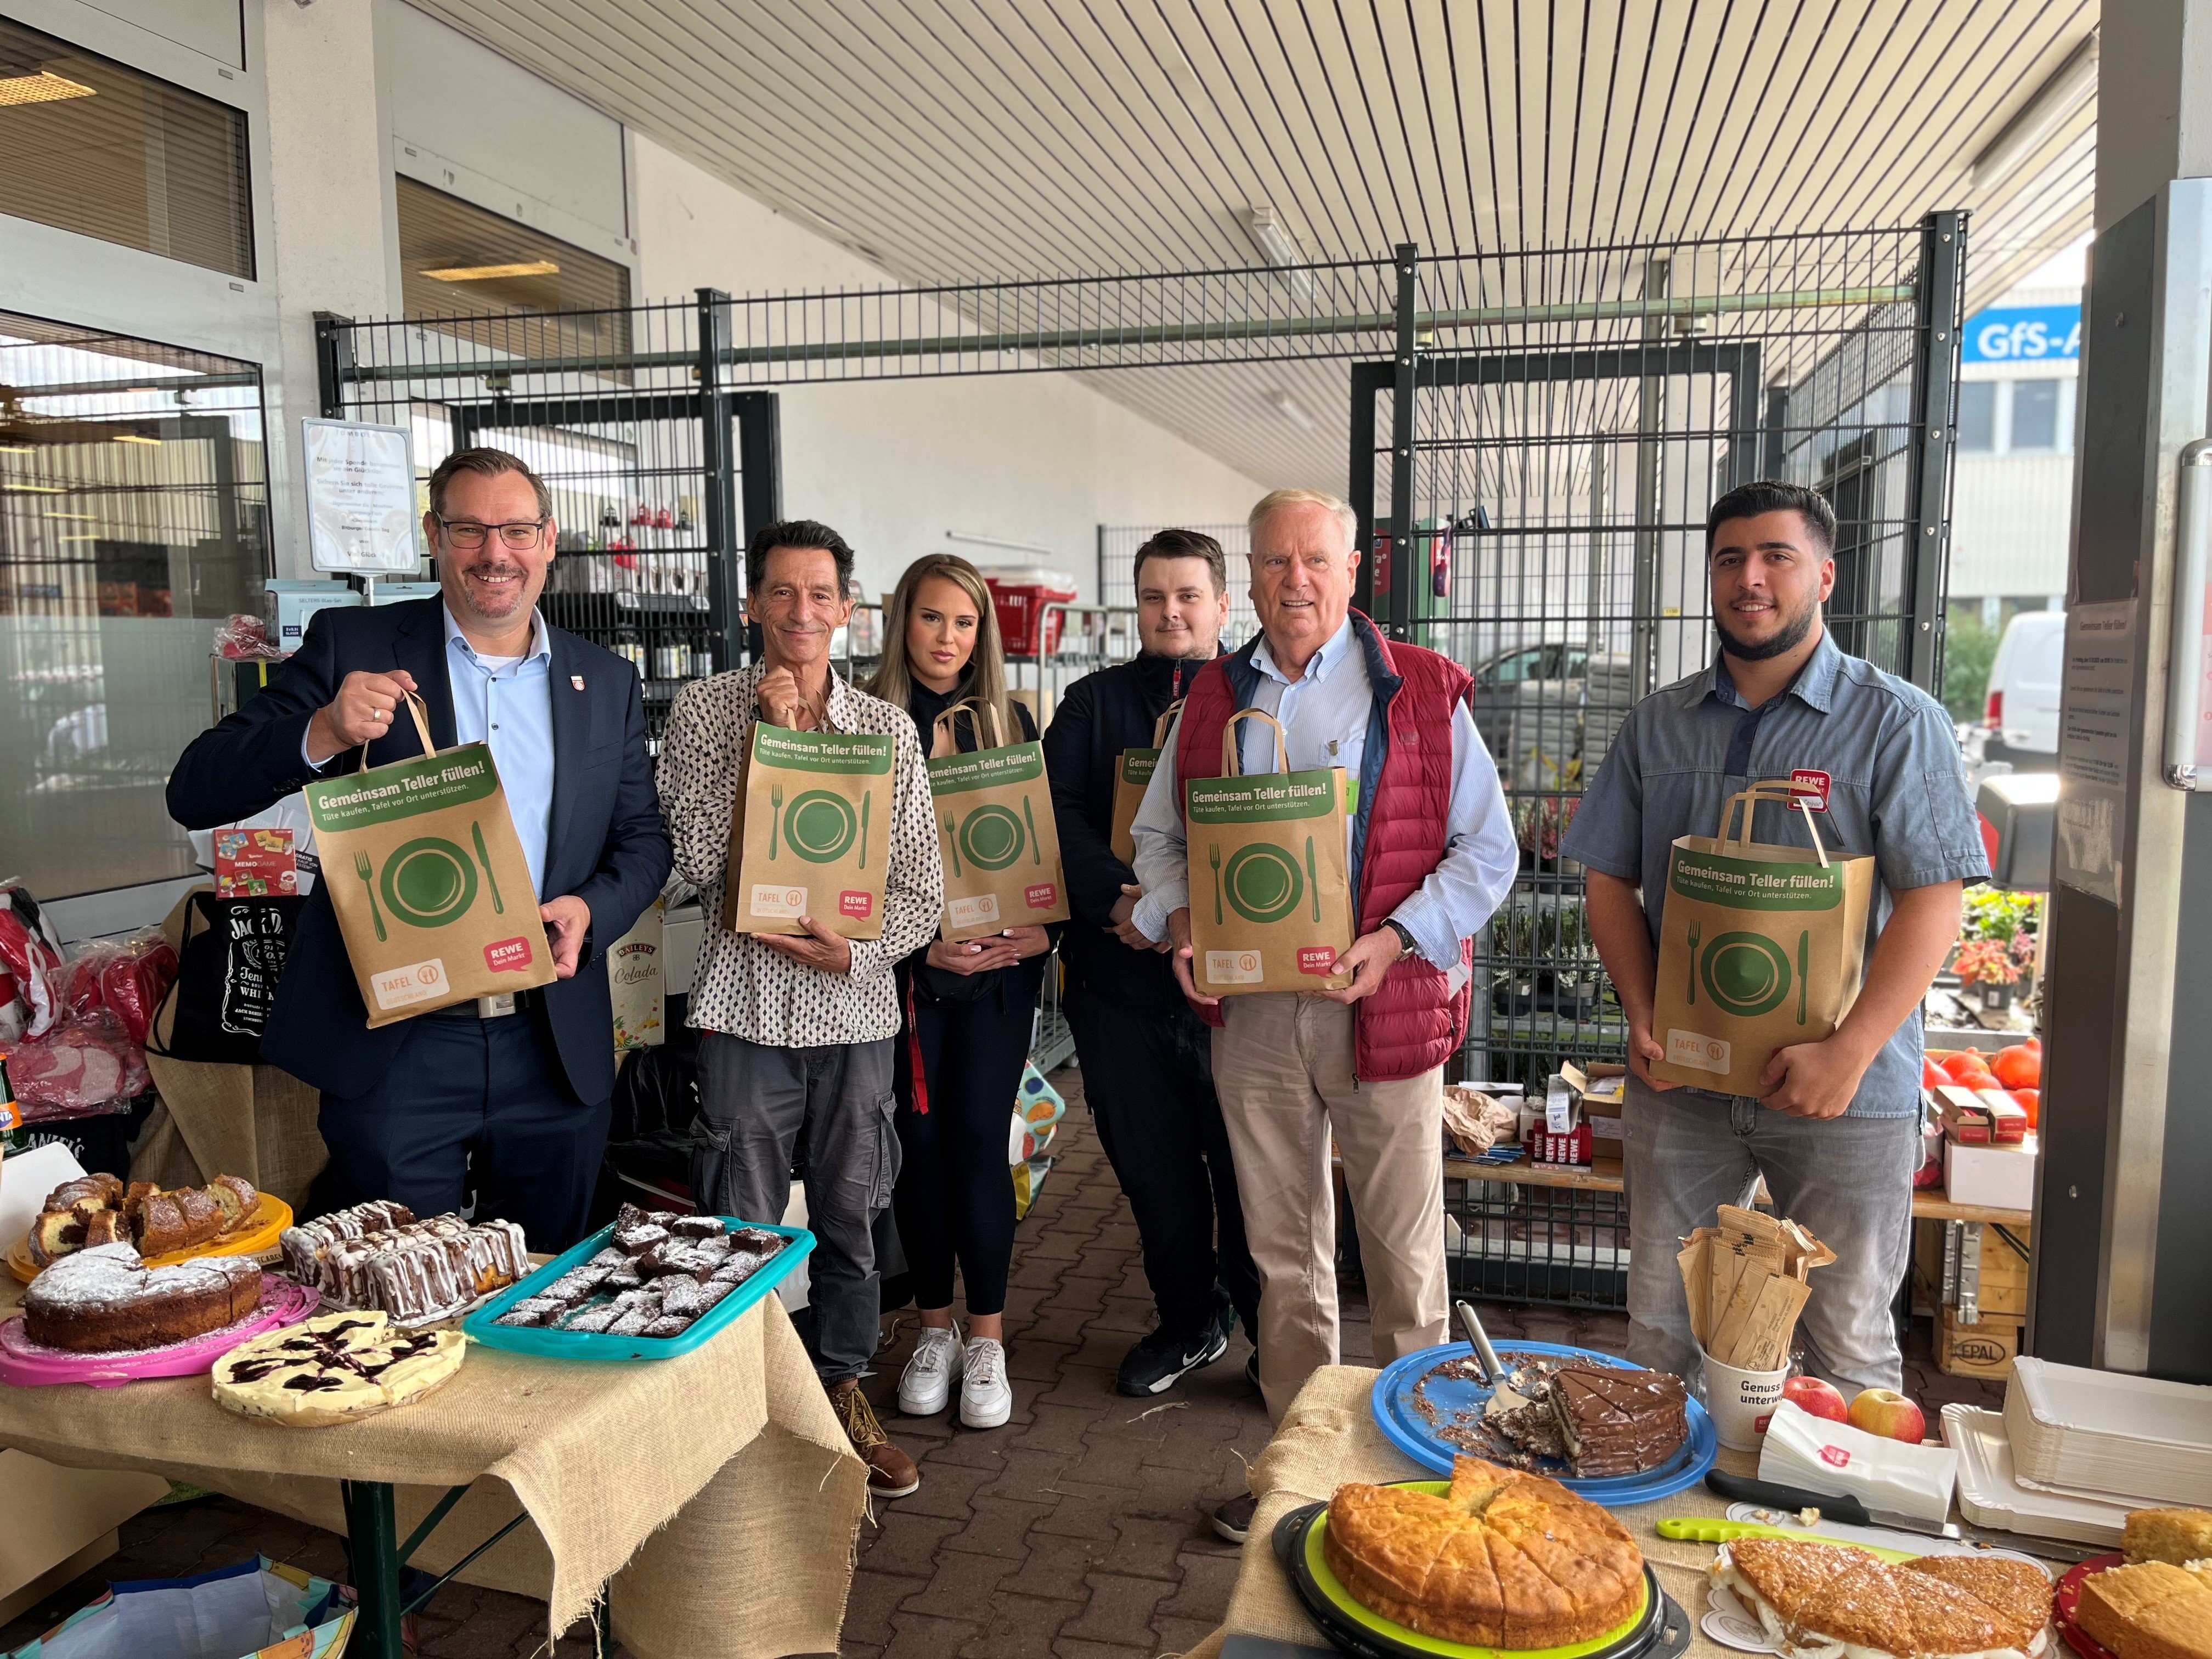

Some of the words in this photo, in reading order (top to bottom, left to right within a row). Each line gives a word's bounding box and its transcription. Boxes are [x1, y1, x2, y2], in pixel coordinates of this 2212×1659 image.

[761, 734, 818, 753] Gemeinsam
[821, 744, 850, 755] Teller
[853, 744, 887, 756] füllen!
[979, 759, 1004, 770] Teller
[1006, 752, 1036, 766] füllen!
[319, 785, 400, 810] Gemeinsam
[402, 774, 439, 792] Teller
[441, 761, 485, 783] füllen!
[1795, 776, 1825, 786] REWE
[1193, 790, 1251, 803] Gemeinsam
[1254, 787, 1285, 800] Teller
[1288, 783, 1326, 797] füllen!
[321, 813, 339, 821] Tüte
[371, 800, 390, 811] Tafel
[392, 798, 404, 806] vor
[406, 795, 419, 803] Ort
[420, 783, 469, 800] unterstützen.
[1267, 801, 1310, 810] unterstützen.
[1678, 860, 1745, 885] Gemeinsam
[1750, 873, 1787, 888] Teller
[1790, 875, 1834, 888] füllen!
[1676, 876, 1689, 885] Tüte
[1716, 884, 1732, 894] Tafel
[758, 893, 780, 902] TAFEL
[844, 896, 867, 905] REWE
[1029, 888, 1051, 898] REWE
[955, 905, 974, 915] TAFEL
[490, 943, 523, 959] REWE
[619, 945, 653, 955] BAILEYS
[1302, 951, 1330, 962] REWE
[493, 958, 506, 967] Dein
[507, 952, 525, 962] Markt
[1212, 959, 1234, 969] TAFEL
[614, 964, 658, 984] Colada
[381, 977, 412, 992] TAFEL
[1674, 1039, 1700, 1053] TAFEL
[0, 1111, 13, 1122] NTA
[1534, 1133, 1543, 1158] REWE
[1962, 1345, 1998, 1360] EPAL
[1741, 1380, 1780, 1392] Genuss
